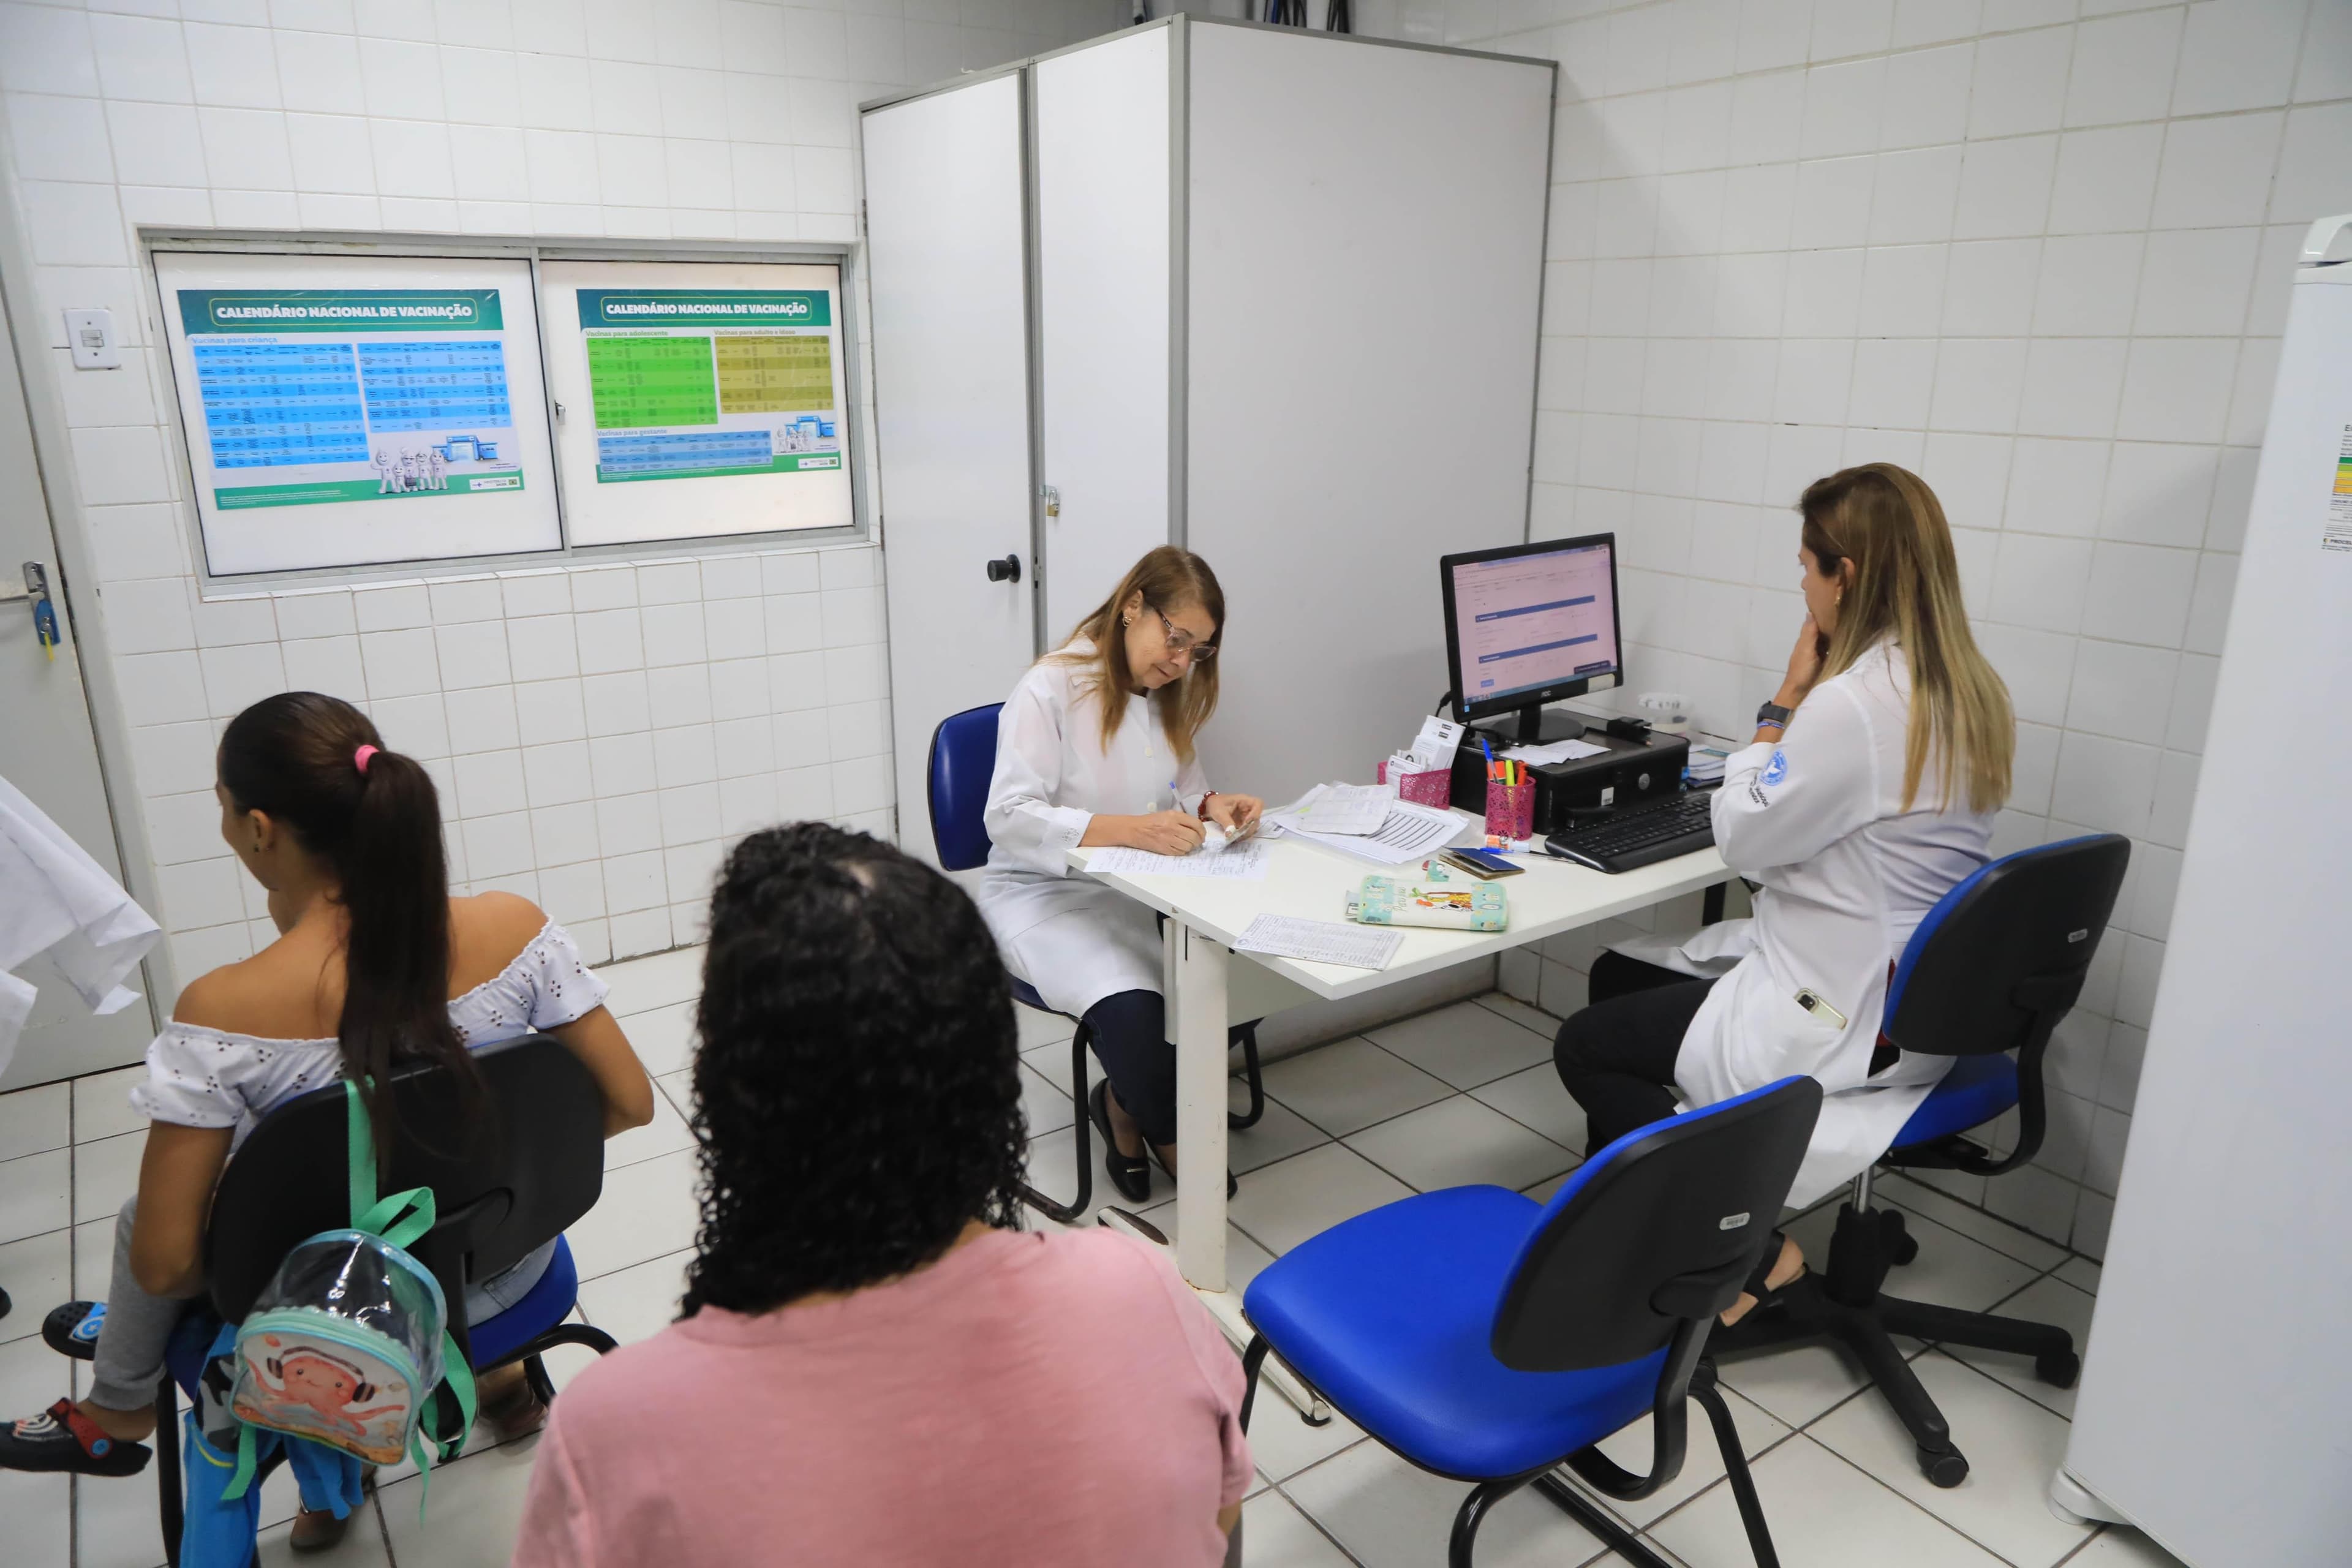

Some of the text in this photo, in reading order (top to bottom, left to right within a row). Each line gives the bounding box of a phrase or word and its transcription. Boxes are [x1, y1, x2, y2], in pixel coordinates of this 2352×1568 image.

[216, 303, 472, 320] CALENDÁRIO NACIONAL DE VACINAÇÃO
[606, 302, 807, 316] CALENDÁRIO NACIONAL DE VACINAÇÃO
